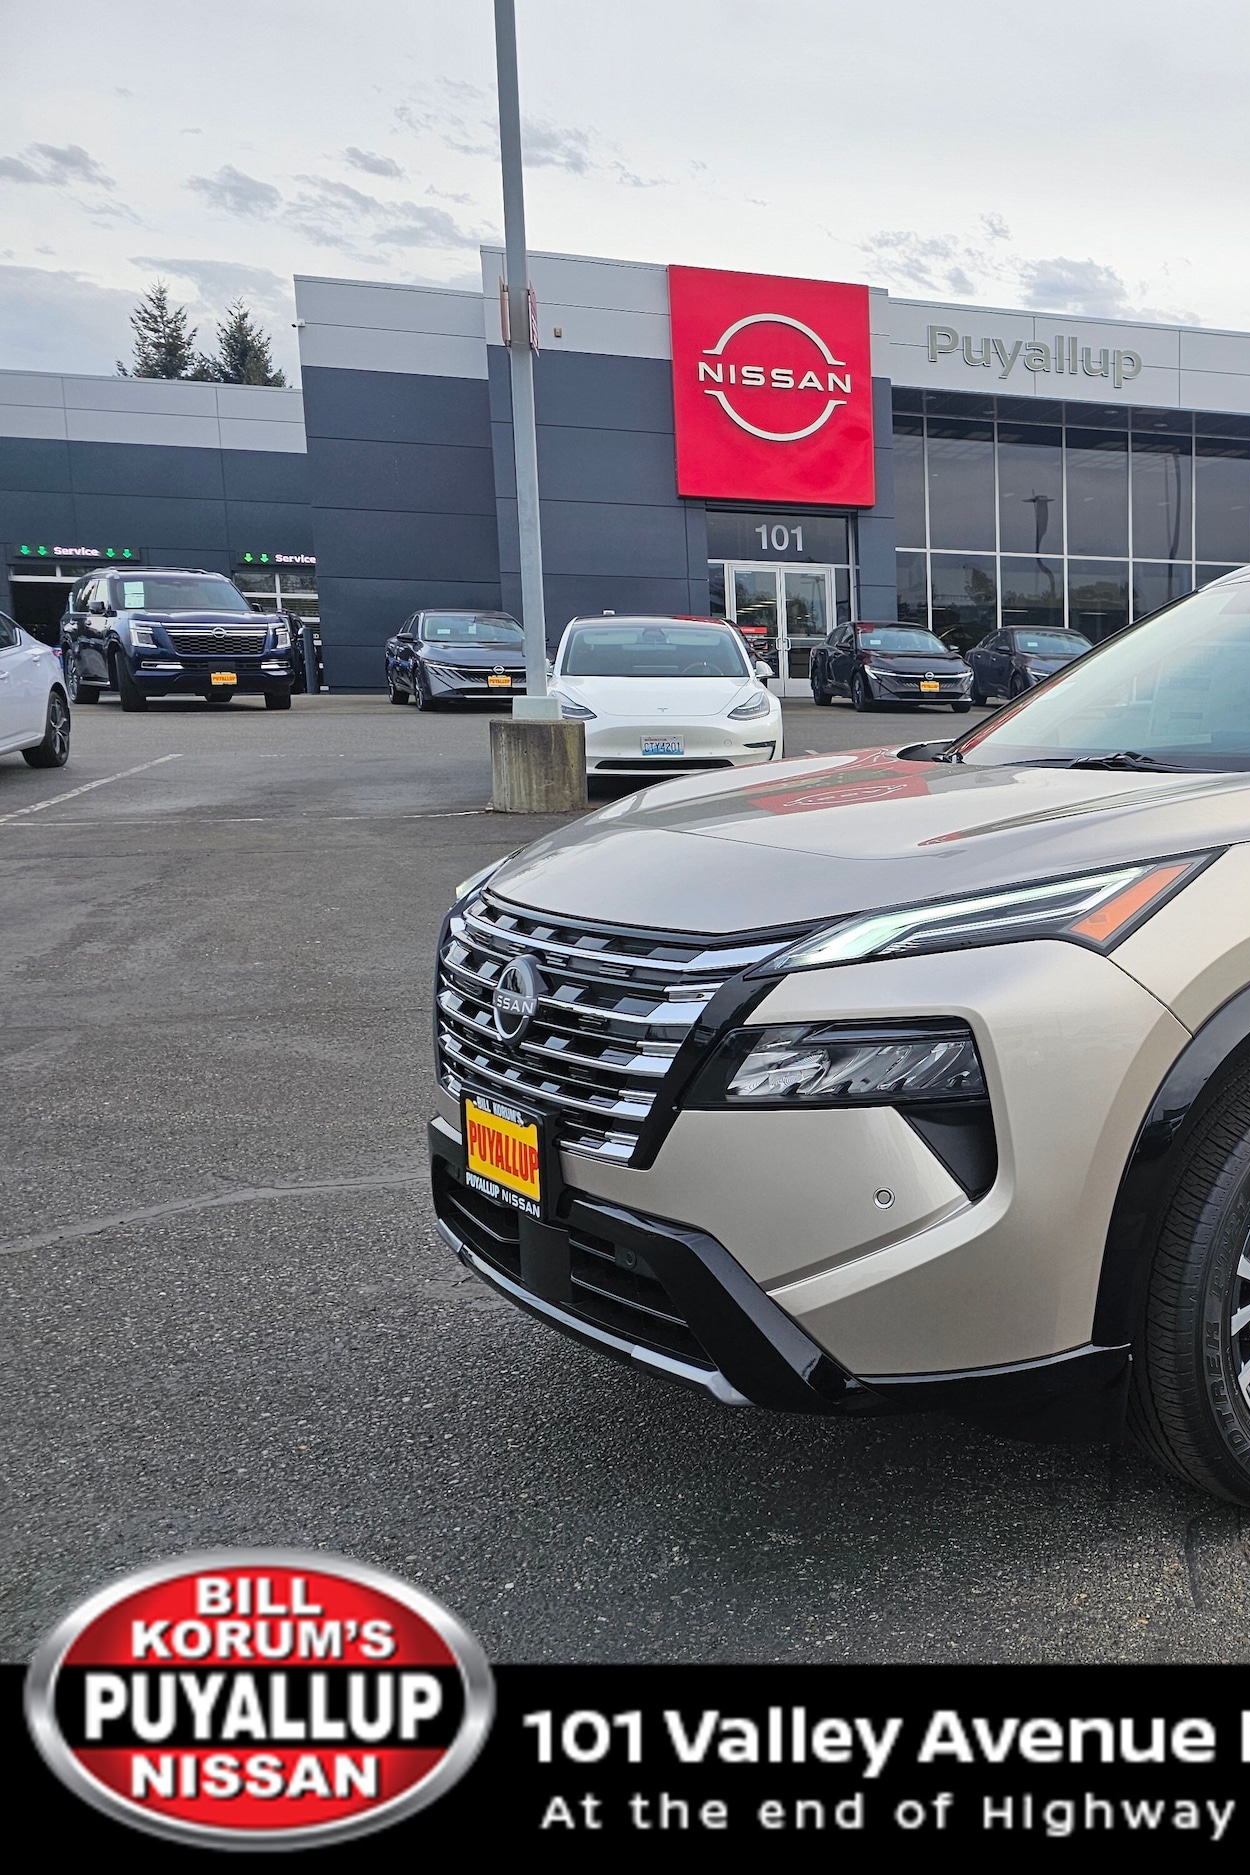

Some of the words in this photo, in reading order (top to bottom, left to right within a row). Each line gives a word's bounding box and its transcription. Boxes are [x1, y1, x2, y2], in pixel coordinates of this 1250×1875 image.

[927, 325, 1143, 389] Puyallup
[698, 361, 852, 395] NISSAN
[53, 546, 100, 557] Service
[754, 523, 804, 553] 101
[275, 554, 317, 564] Service
[497, 994, 534, 1014] SSAN
[476, 1096, 491, 1113] BILL
[468, 1119, 539, 1185] PUYALLUP
[466, 1171, 500, 1198] PUYALLUP
[501, 1190, 540, 1218] NISSAN
